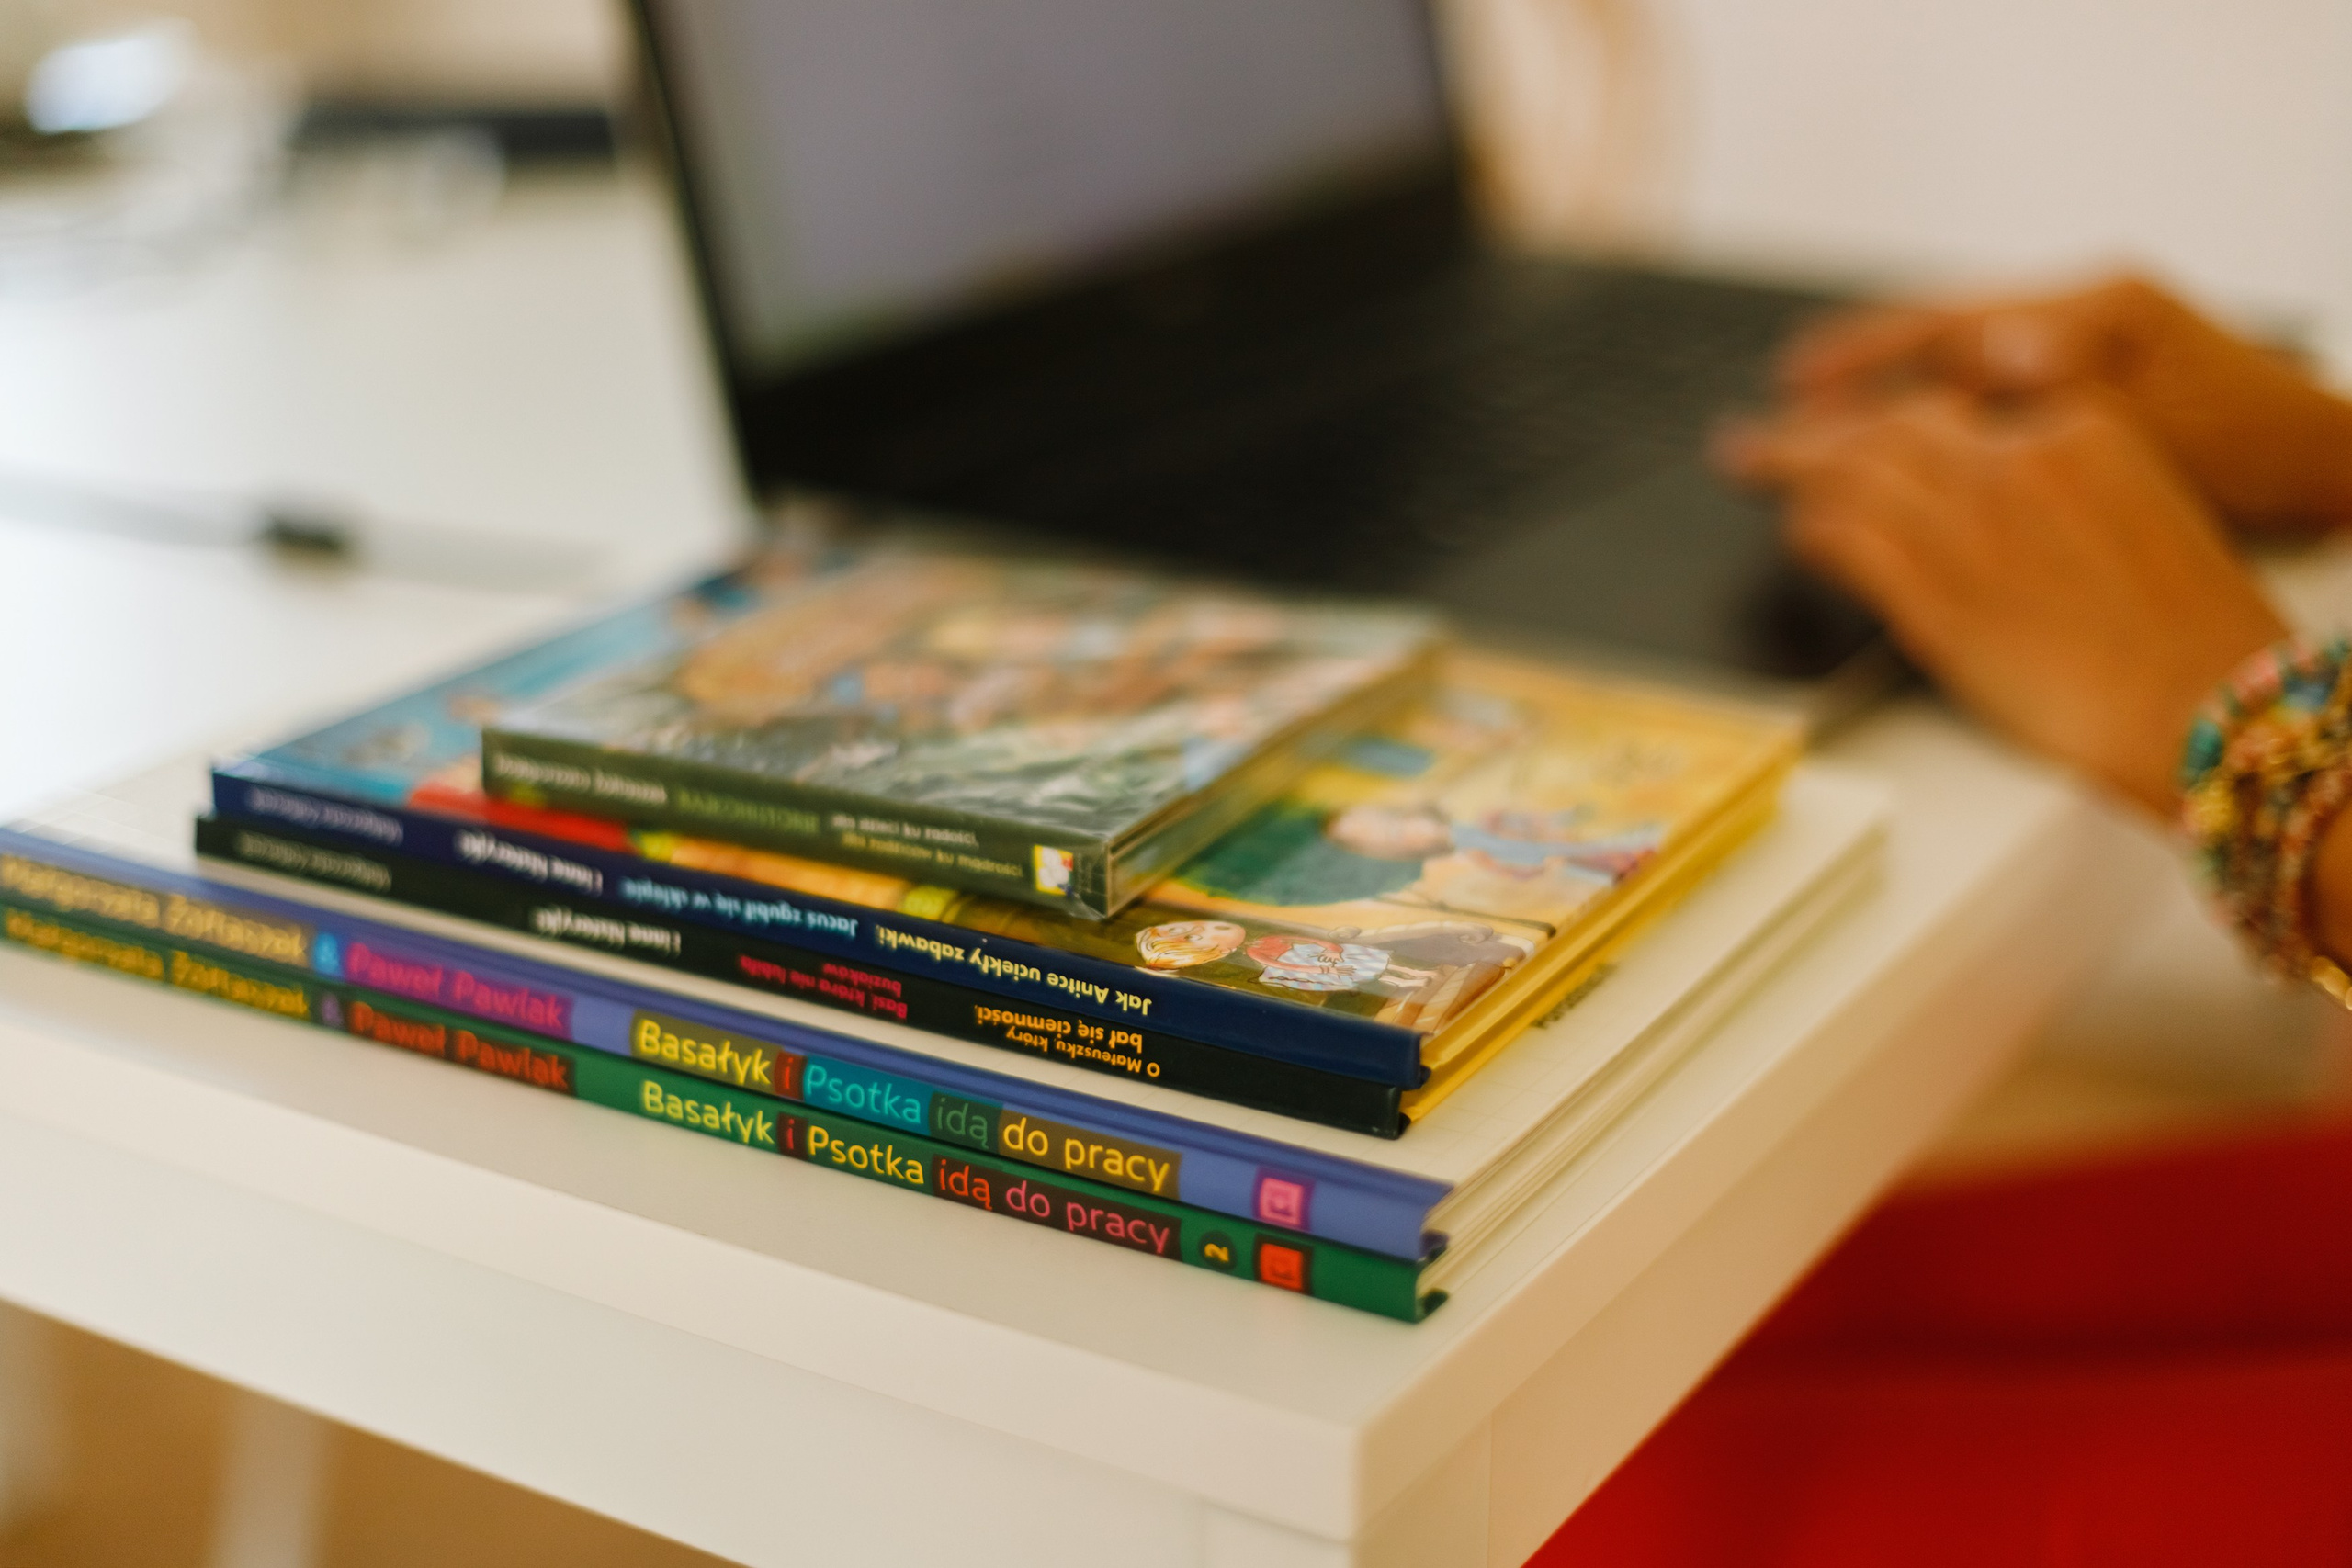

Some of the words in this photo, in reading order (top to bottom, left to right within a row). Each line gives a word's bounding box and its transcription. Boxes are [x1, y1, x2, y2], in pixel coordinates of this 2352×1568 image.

[693, 890, 713, 908] w
[968, 947, 1042, 982] uciekły
[346, 942, 443, 999] Paweł
[454, 969, 565, 1031] Pawlak
[1046, 969, 1110, 1006] Anitce
[1115, 992, 1153, 1016] Jak
[1006, 1025, 1049, 1052] który
[1078, 1019, 1105, 1045] się
[1109, 1029, 1143, 1055] bał
[351, 1001, 445, 1057] Paweł
[457, 1030, 568, 1091] Pawlak
[1147, 1062, 1161, 1078] O
[639, 1018, 774, 1086] Basałyk
[785, 1057, 795, 1091] i
[804, 1063, 922, 1124] Psotka
[936, 1097, 989, 1150] idą
[1003, 1116, 1049, 1156] do
[1064, 1137, 1170, 1193] pracy
[643, 1079, 775, 1145] Basałyk
[786, 1119, 796, 1149] i
[808, 1125, 925, 1185] Psotka
[939, 1158, 992, 1212] idą
[1005, 1179, 1051, 1219] do
[1066, 1201, 1170, 1255] pracy
[1204, 1242, 1229, 1263] 2
